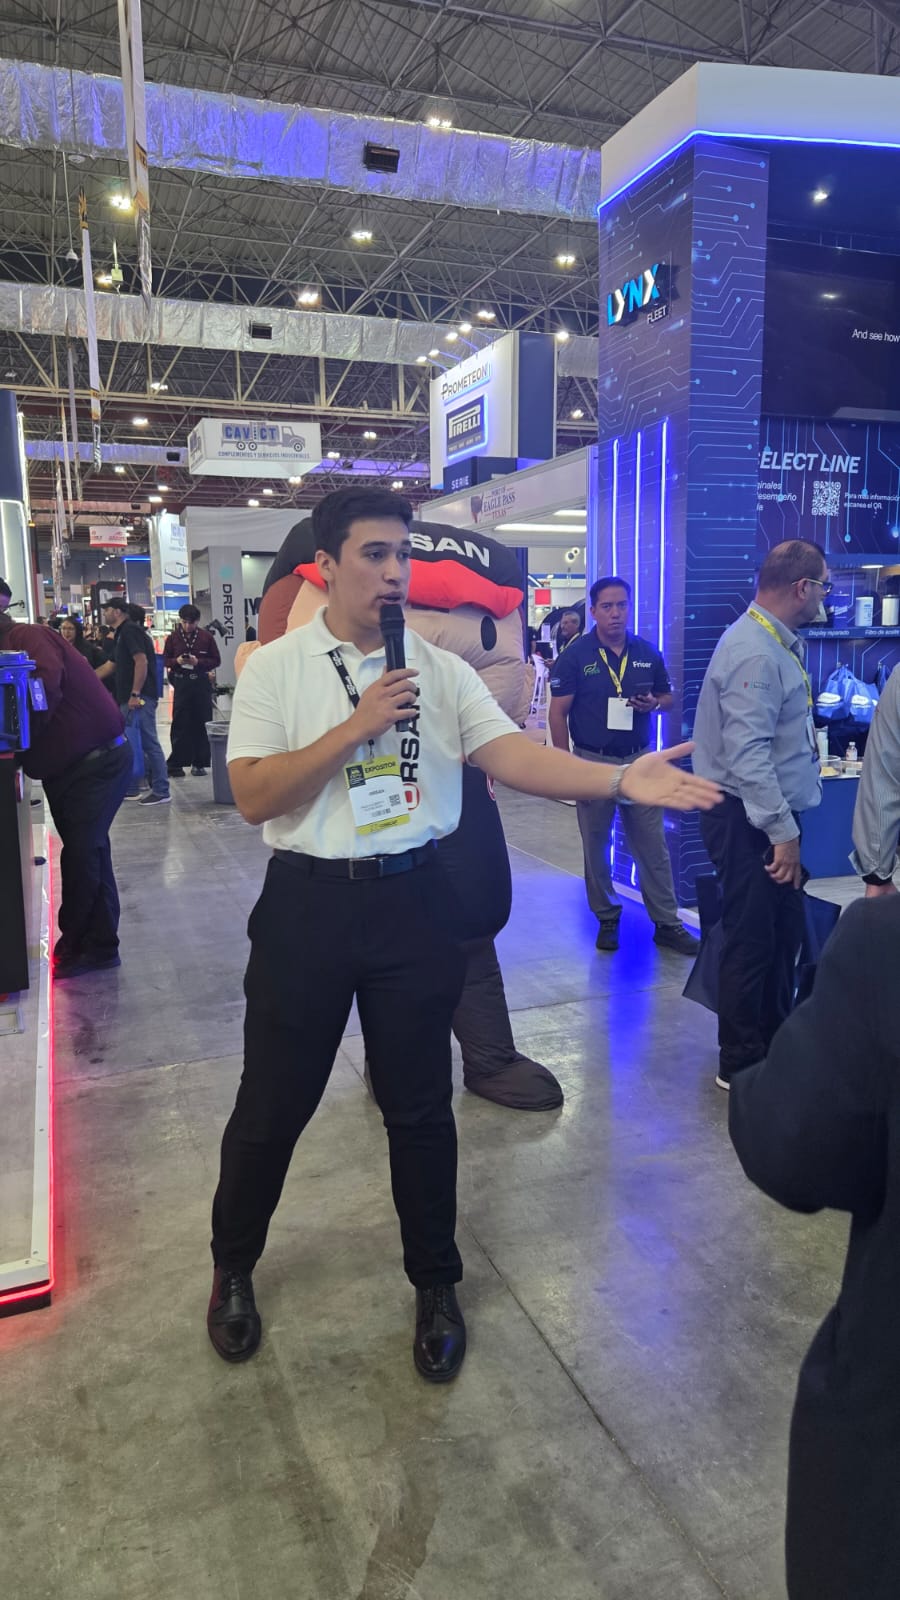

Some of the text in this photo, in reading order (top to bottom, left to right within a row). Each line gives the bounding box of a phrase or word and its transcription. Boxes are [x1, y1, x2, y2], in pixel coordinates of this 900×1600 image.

[607, 263, 660, 327] LYNX
[647, 304, 667, 324] FLEET
[851, 328, 868, 340] And
[869, 332, 883, 341] see
[441, 363, 488, 400] PROMETEON
[448, 404, 481, 439] PIRELLI
[758, 450, 861, 474] ELECT LINE
[451, 475, 470, 490] SERIE
[483, 491, 516, 513] EAGLE PASS
[757, 493, 798, 503] esempeño
[364, 761, 397, 774] EXPOSITOR
